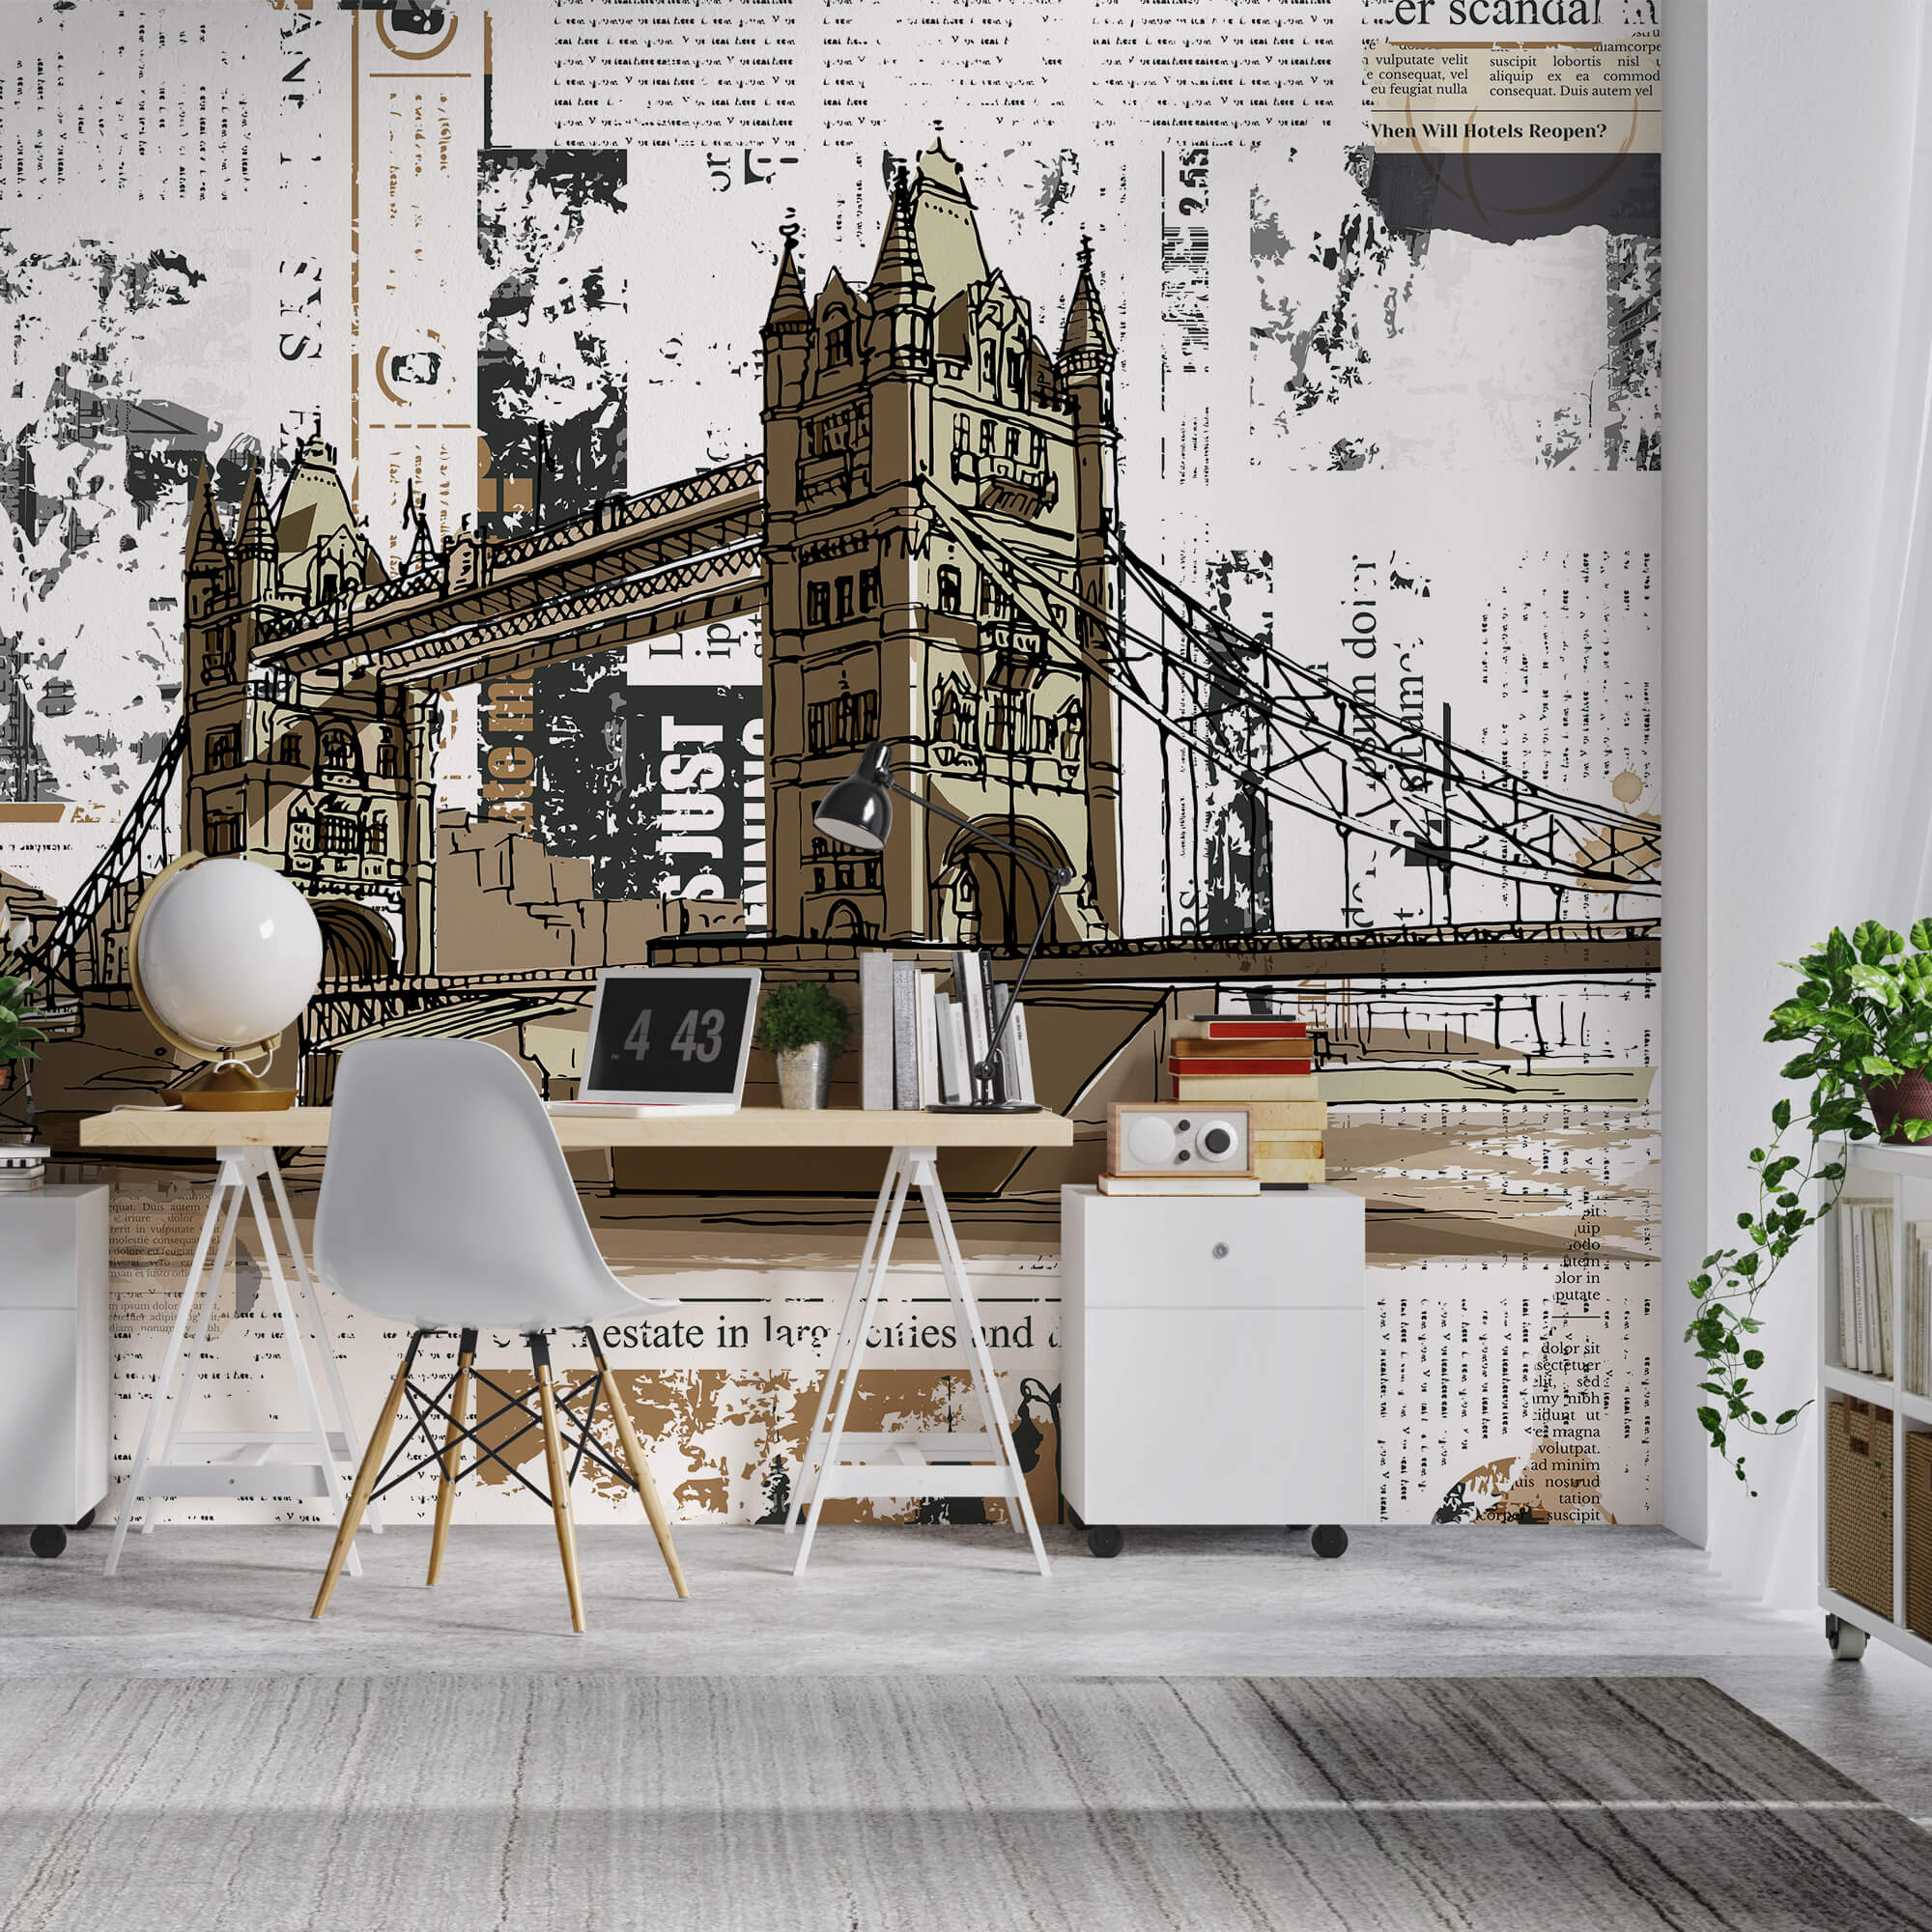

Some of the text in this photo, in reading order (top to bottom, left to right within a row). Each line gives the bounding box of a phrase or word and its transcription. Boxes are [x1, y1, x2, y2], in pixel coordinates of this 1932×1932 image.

[1376, 54, 1469, 68] vulputate velit
[1490, 54, 1639, 70] suscipit lobortis nisl
[1379, 71, 1445, 82] consequat,
[1450, 69, 1468, 79] vel
[1490, 70, 1534, 84] aliquip
[1548, 72, 1562, 82] ex
[1576, 72, 1590, 82] ea
[1371, 83, 1468, 97] eu feugiat nulla
[1490, 84, 1653, 99] consequat. Duis autem vel
[1422, 123, 1458, 138] Will
[1464, 123, 1523, 138] Hotels
[1529, 123, 1607, 141] Reopen?
[660, 715, 724, 859] JUST
[624, 1009, 652, 1061] 4
[670, 1009, 725, 1063] 43
[143, 1202, 164, 1211] Duis
[168, 1213, 194, 1222] dolor
[151, 1224, 195, 1236] vulputate
[1574, 1222, 1601, 1236] uip
[1586, 1271, 1600, 1283] in
[1552, 1290, 1601, 1303] putate
[121, 1301, 150, 1312] ipsum
[153, 1301, 178, 1310] dolor
[603, 1319, 704, 1349] estate
[717, 1315, 749, 1348] in
[1541, 1341, 1601, 1354] dolor sit
[1534, 1360, 1602, 1372] sectetuer
[1577, 1375, 1600, 1387] sed
[1586, 1410, 1601, 1421] ut
[1552, 1428, 1601, 1440] magna
[1538, 1441, 1601, 1457] volutpat.
[1530, 1459, 1601, 1471] ad minim
[1545, 1474, 1601, 1488] nostrud
[1559, 1492, 1601, 1504] tation
[1548, 1509, 1601, 1523] suscipit
